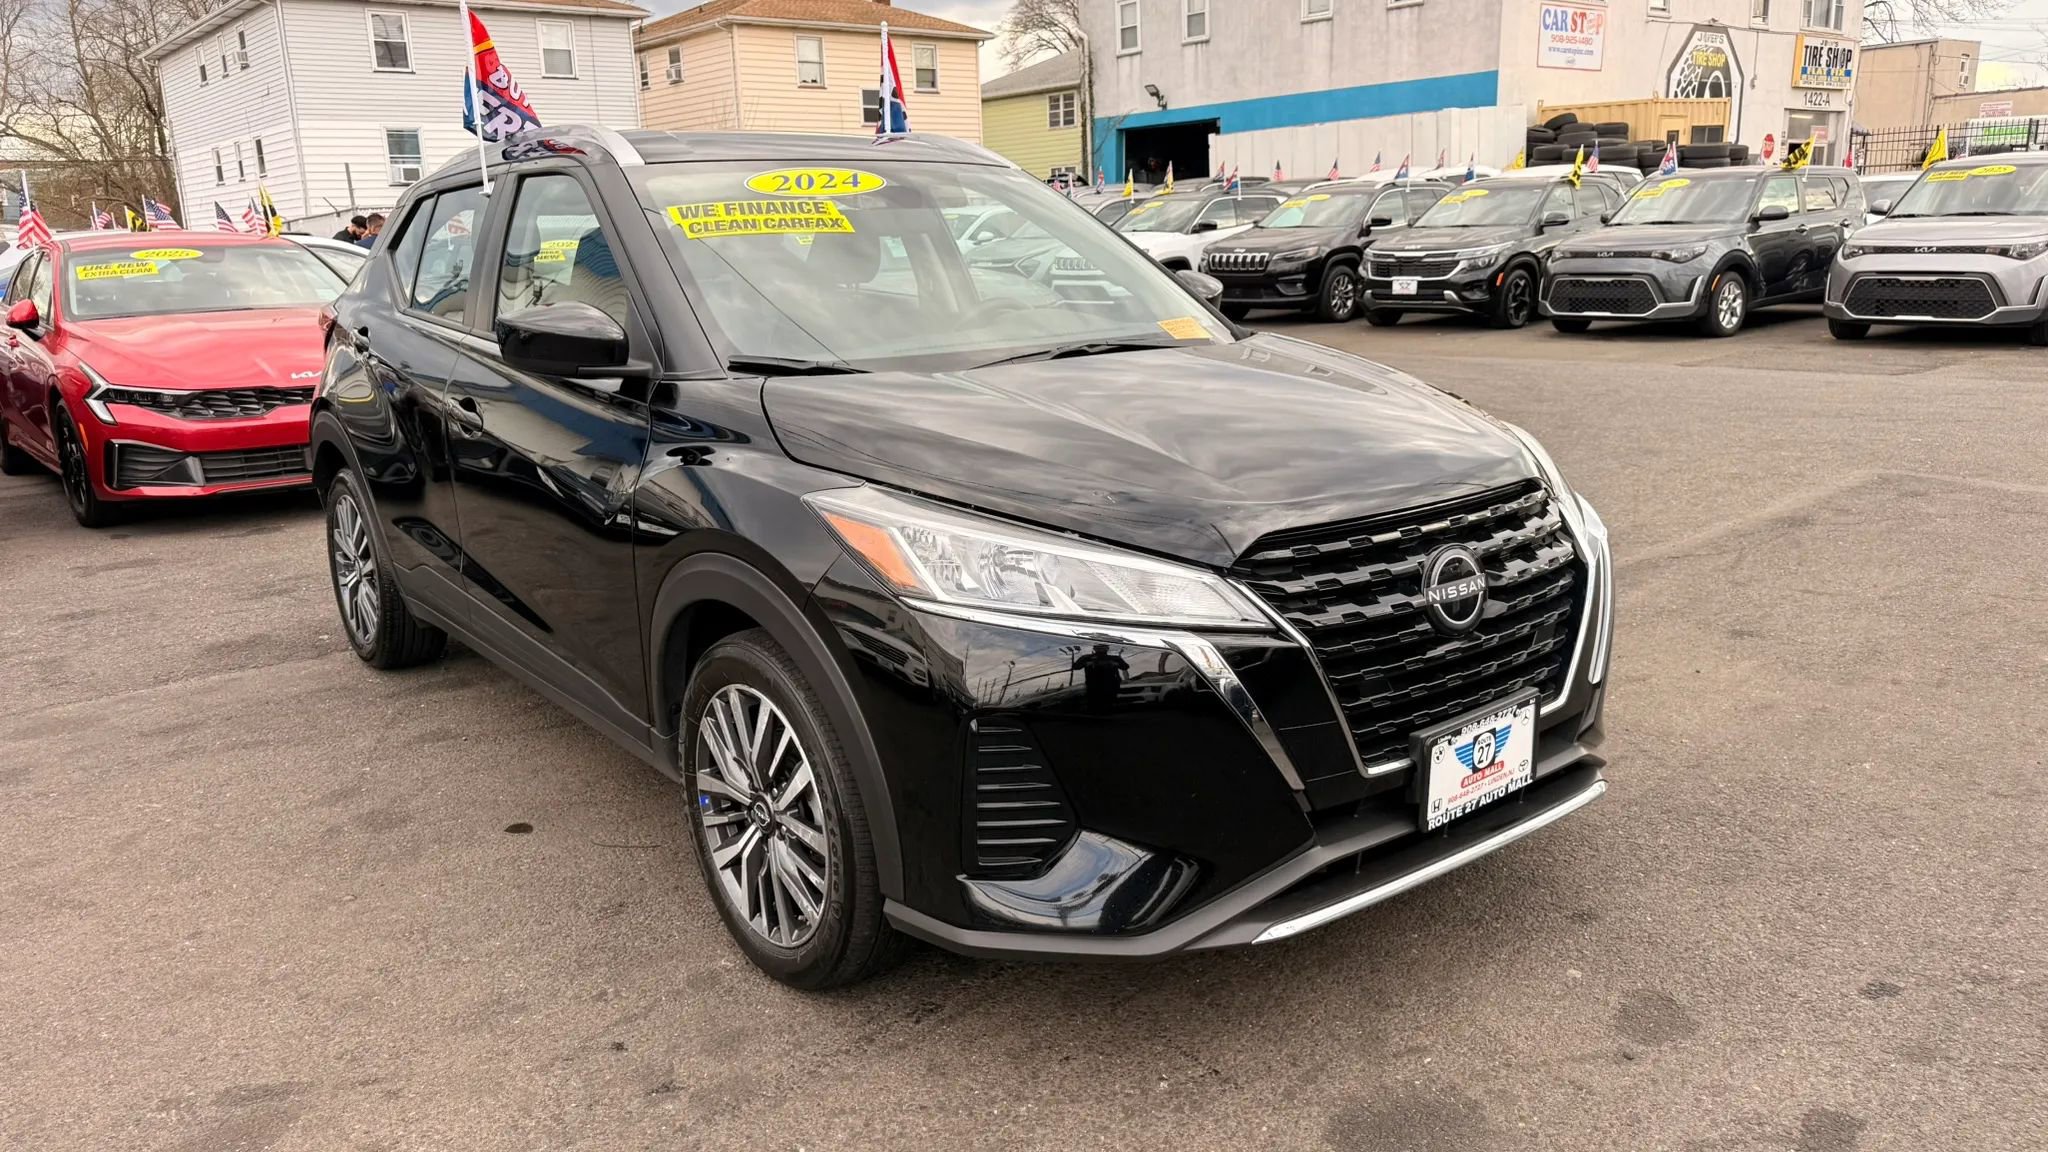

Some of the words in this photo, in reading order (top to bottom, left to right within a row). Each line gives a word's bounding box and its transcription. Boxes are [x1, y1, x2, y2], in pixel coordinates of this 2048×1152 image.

[1542, 8, 1568, 32] CAR
[1692, 50, 1709, 66] TIRE
[1709, 52, 1726, 68] SHOP
[1803, 45, 1824, 67] TIRE
[1826, 47, 1853, 69] SHOP
[1803, 91, 1831, 107] 1422-A
[771, 172, 861, 193] 2024
[677, 203, 718, 220] WE
[724, 201, 829, 217] FINANCE
[688, 219, 759, 234] CLEAN
[763, 216, 845, 231] CARFAX
[144, 250, 190, 258] 2025
[82, 263, 113, 272] LIKE
[117, 260, 150, 269] NEW
[83, 269, 119, 278] EXTRA
[120, 267, 153, 276] CLEAN
[1428, 575, 1486, 603] NISSAN
[1477, 735, 1493, 747] ROUTE
[1477, 742, 1492, 766] 27
[1462, 773, 1483, 787] AUTO
[1484, 762, 1503, 775] MALL
[1427, 807, 1463, 831] ROUTE
[1465, 800, 1478, 813] 27
[1479, 787, 1506, 808] AUTO
[1507, 774, 1533, 794] MALL
